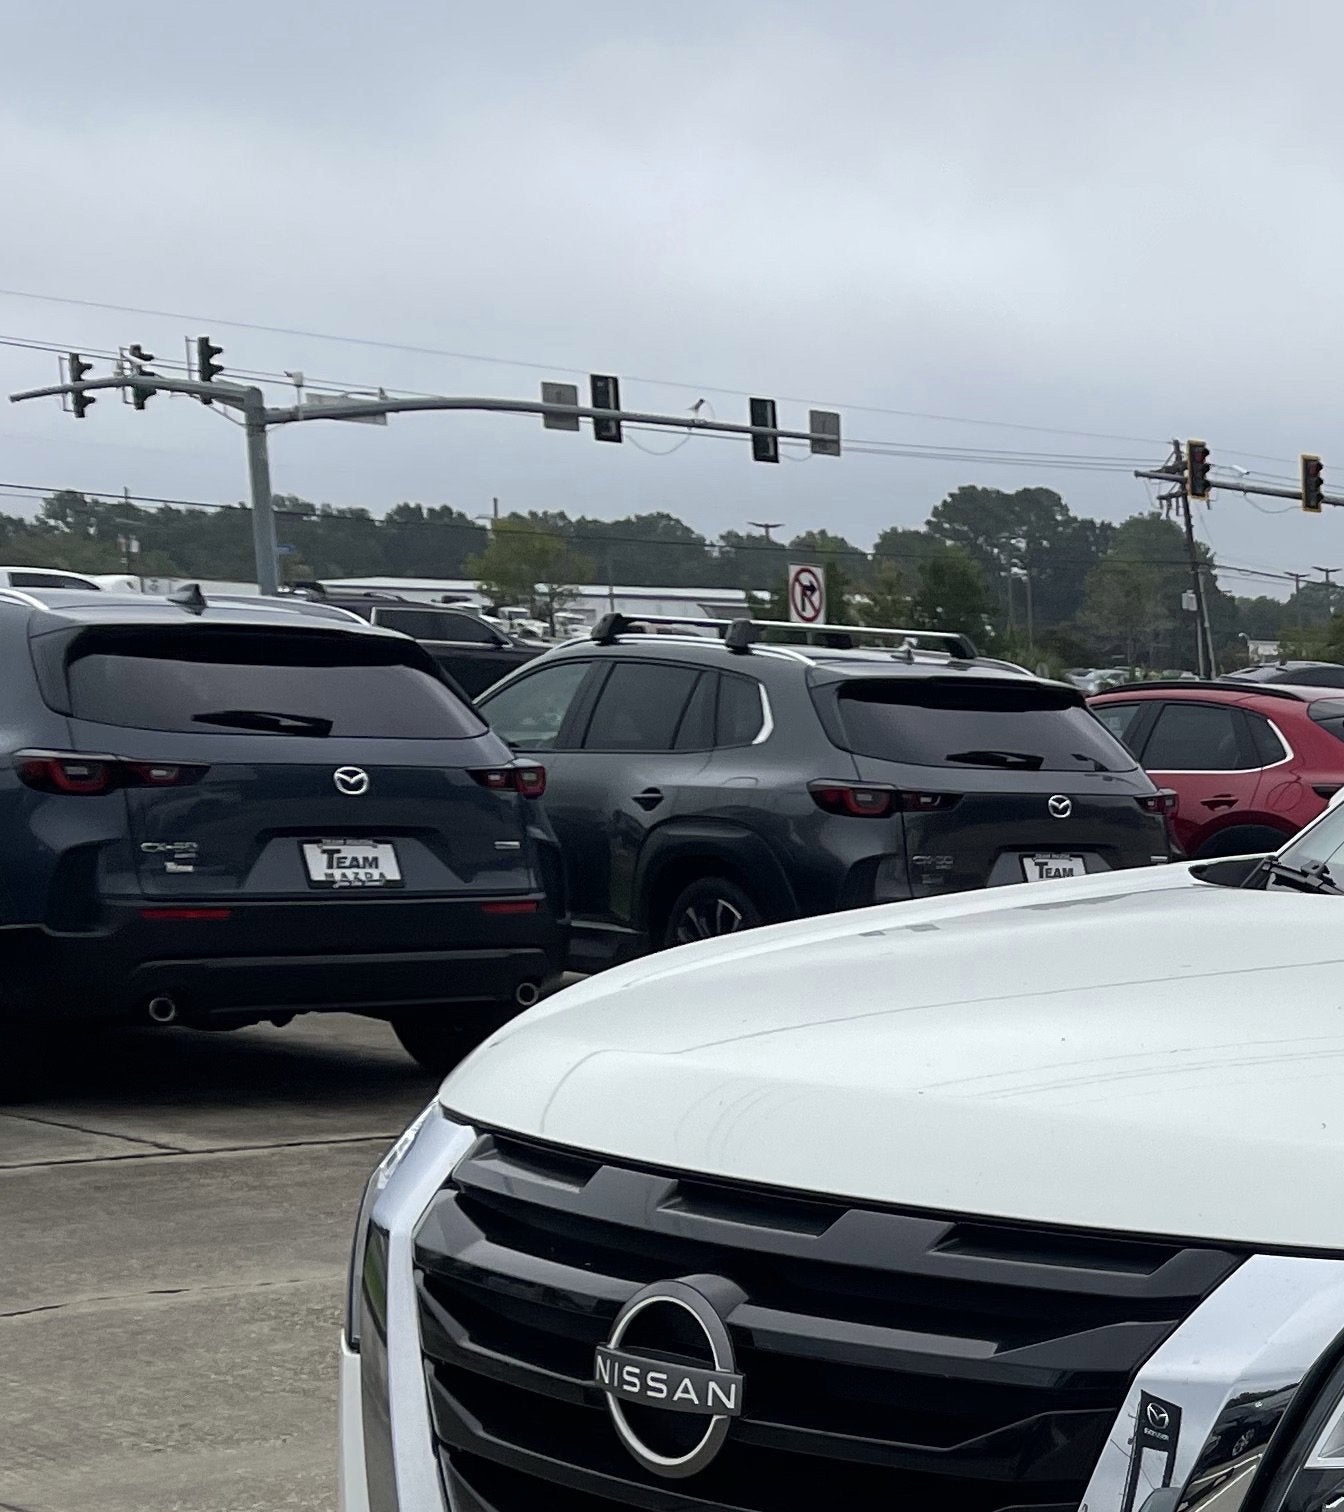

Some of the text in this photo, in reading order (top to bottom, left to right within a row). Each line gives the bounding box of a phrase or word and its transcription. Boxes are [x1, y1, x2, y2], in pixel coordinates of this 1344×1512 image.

[321, 849, 378, 869] TEAM
[1035, 861, 1074, 878] TEAM
[596, 1355, 736, 1409] NISSAN
